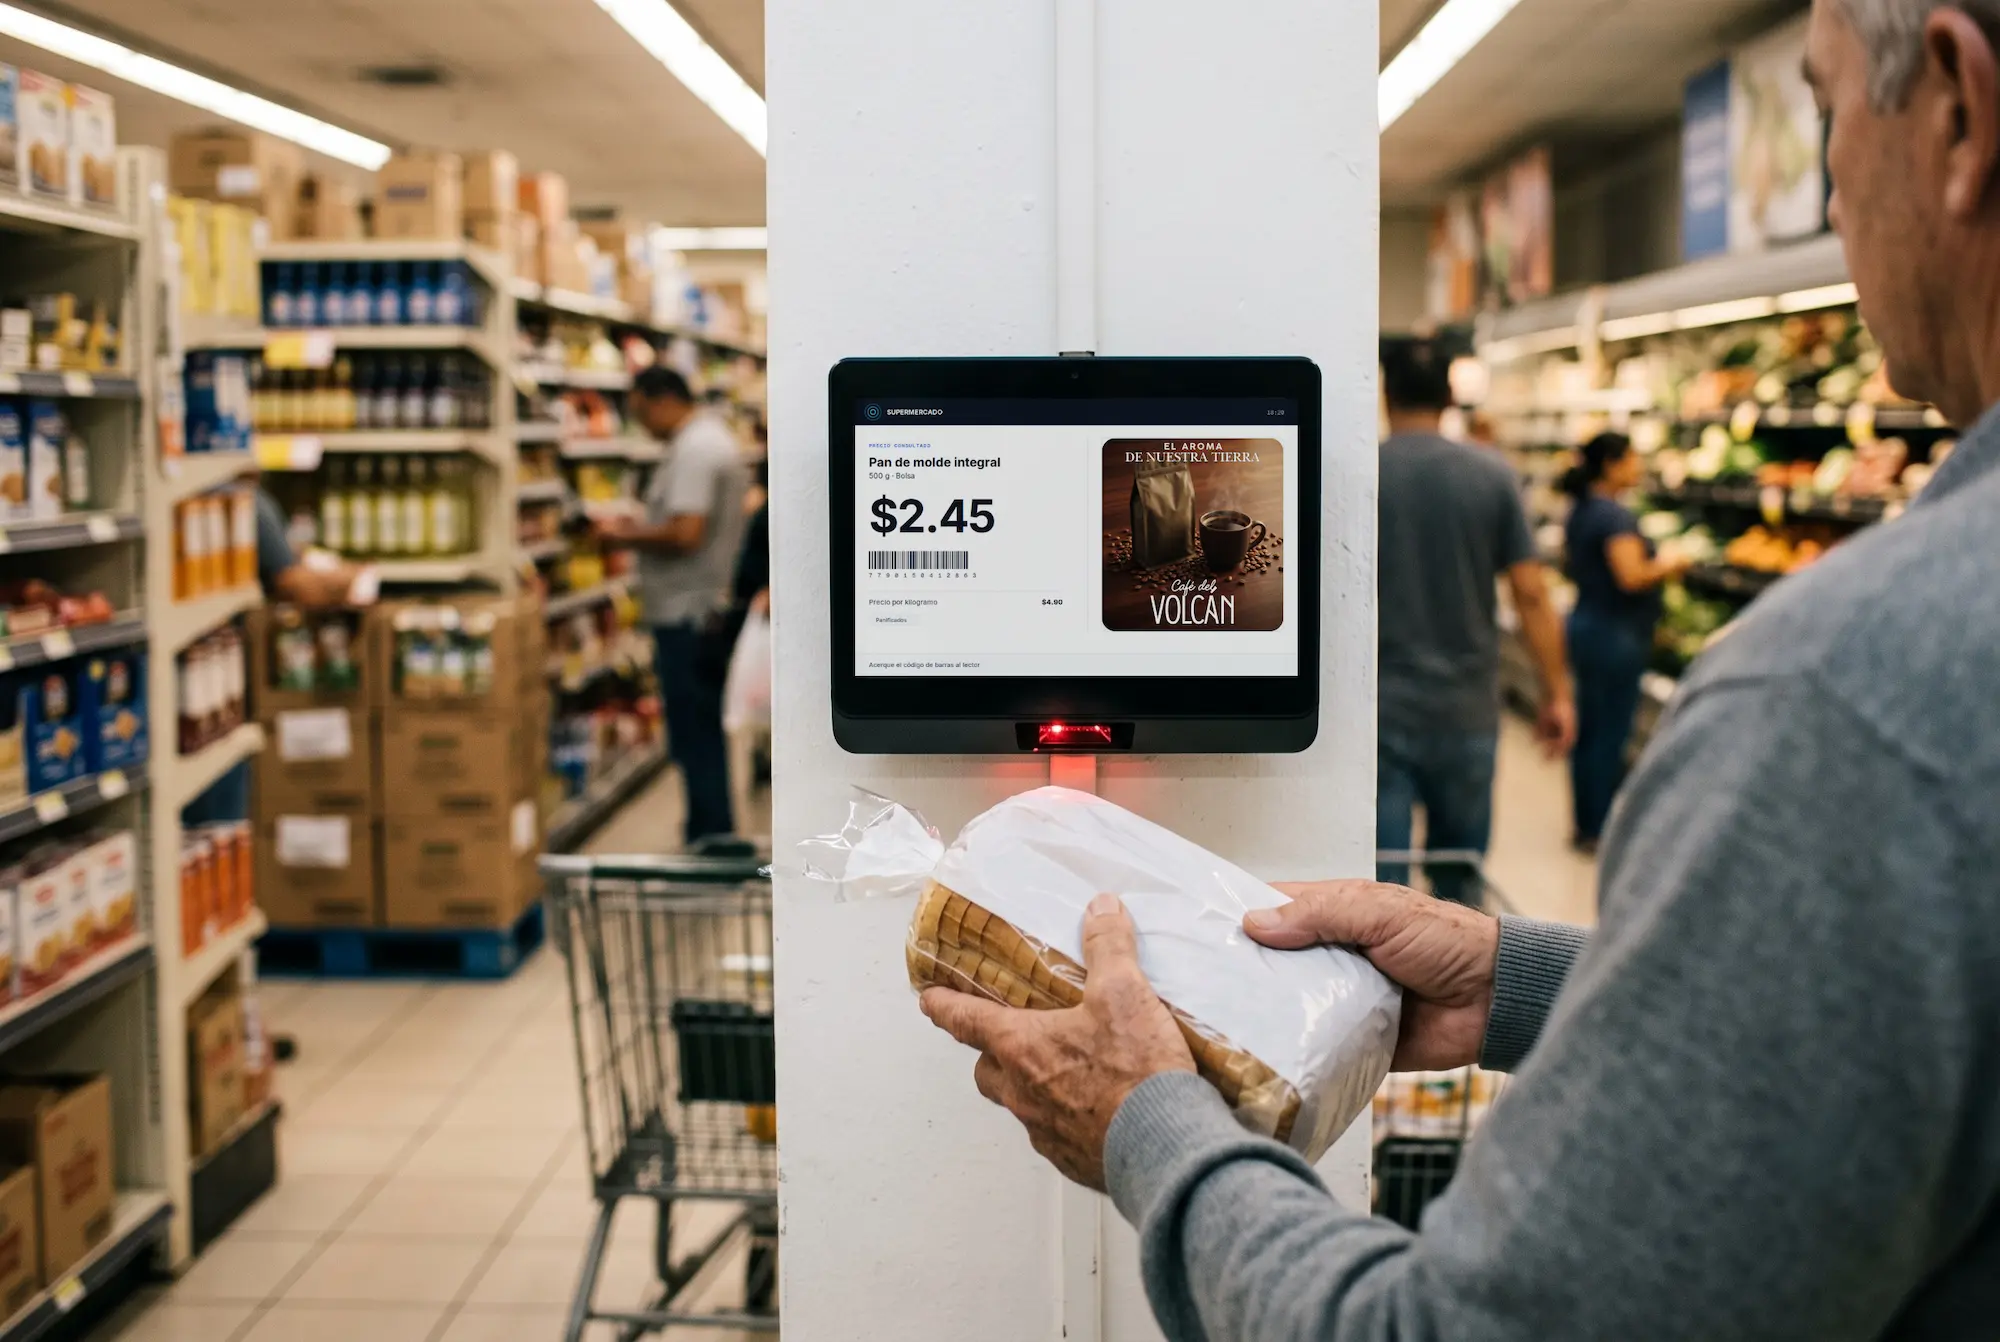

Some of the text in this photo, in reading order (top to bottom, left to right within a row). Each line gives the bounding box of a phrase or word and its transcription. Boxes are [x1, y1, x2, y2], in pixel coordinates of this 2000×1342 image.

[1164, 442, 1223, 450] EL AROMA
[869, 456, 1001, 469] Pan de molde integral
[1125, 452, 1259, 462] DE NUESTRA TIERRA
[870, 494, 995, 537] $2.45
[1171, 579, 1217, 596] Café del
[1150, 586, 1234, 624] VOLCÁN
